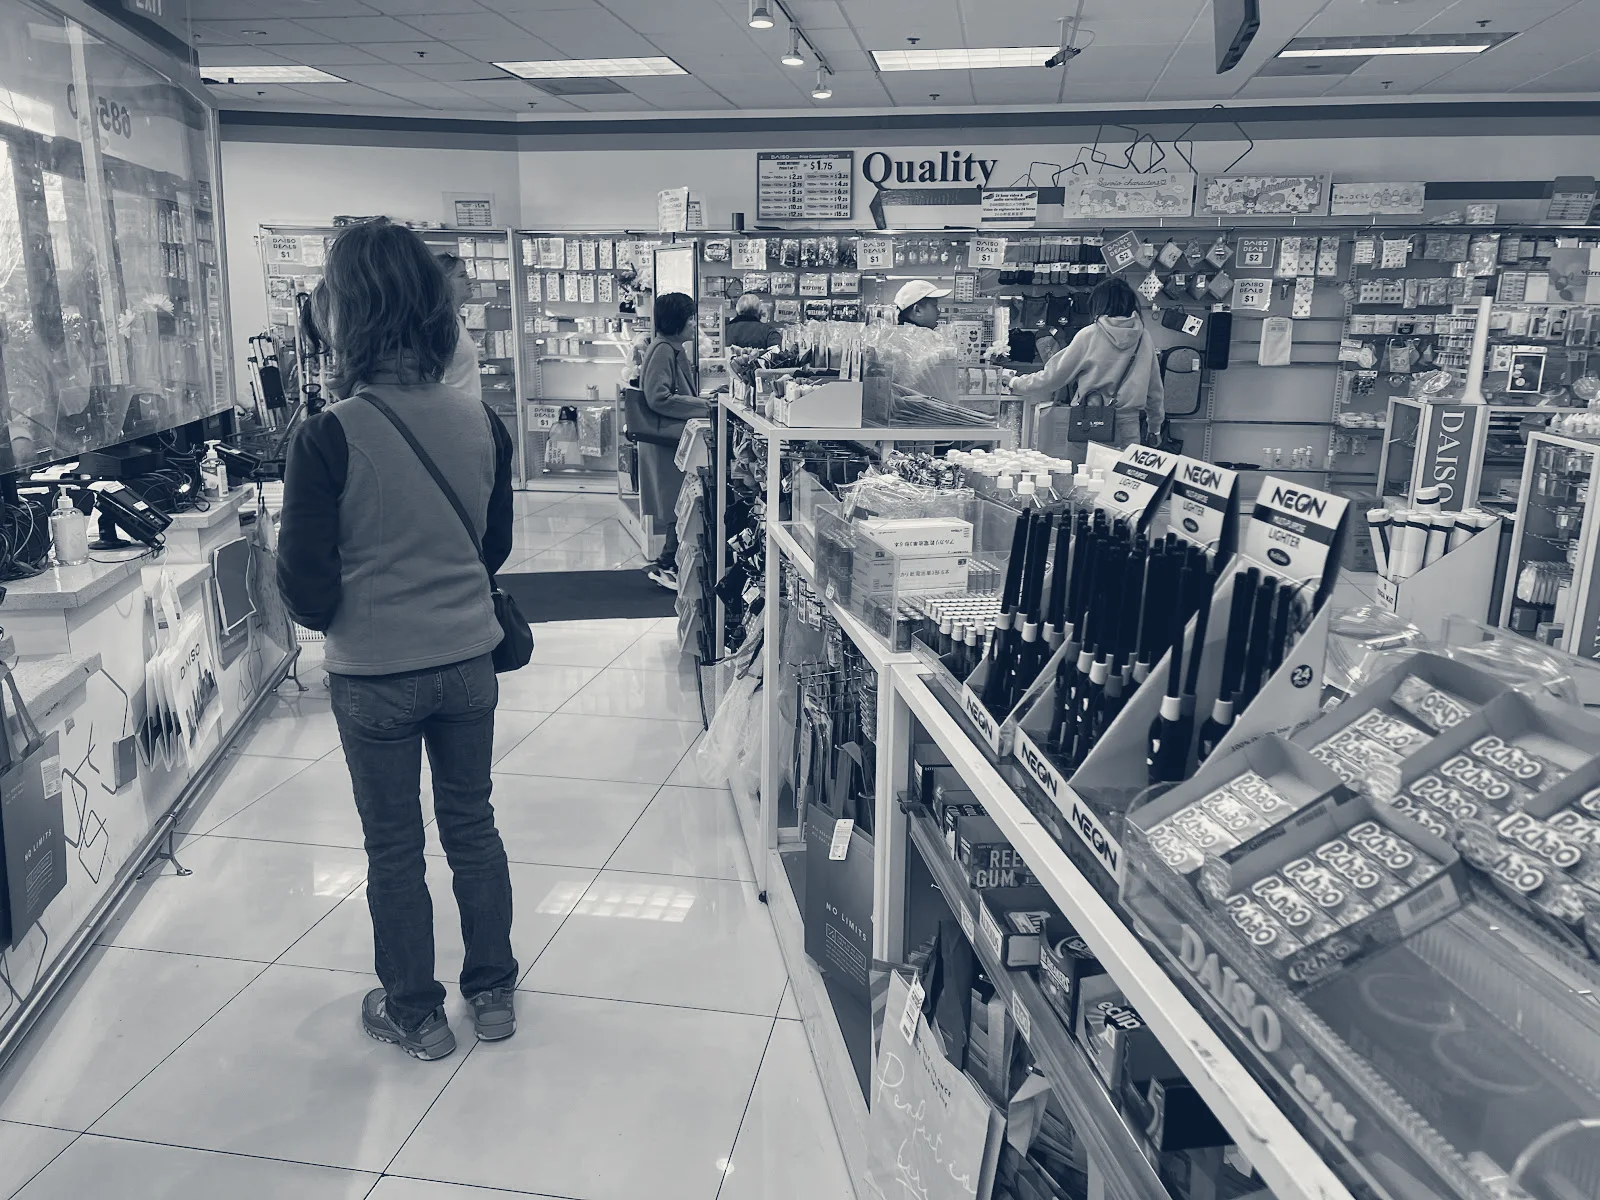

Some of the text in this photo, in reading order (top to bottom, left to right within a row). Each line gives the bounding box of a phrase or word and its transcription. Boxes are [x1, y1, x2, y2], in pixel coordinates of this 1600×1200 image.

[810, 160, 833, 171] $1.75
[862, 150, 999, 191] Quality
[1106, 236, 1130, 251] DAISO
[1109, 242, 1132, 257] DEALS
[1119, 252, 1130, 262] $2
[1249, 254, 1259, 262] $2
[1244, 295, 1254, 303] $1
[1129, 449, 1168, 470] NEON
[1433, 410, 1466, 505] DAISO
[1119, 478, 1141, 491] LIGHTER
[1184, 463, 1223, 490] NEON
[1182, 501, 1205, 518] LIGHTER
[1270, 485, 1329, 519] NEON
[1267, 526, 1301, 549] LIGHTER
[180, 642, 200, 680] DAISO
[1292, 666, 1312, 682] 24
[966, 695, 994, 741] NEON
[1021, 741, 1059, 798] NEON
[24, 848, 33, 862] NO
[33, 828, 52, 852] LIMITS
[1072, 803, 1118, 872] NEON
[976, 869, 1015, 888] GUM
[826, 901, 867, 942] NO LIMITS
[1180, 923, 1283, 1053] DAISO
